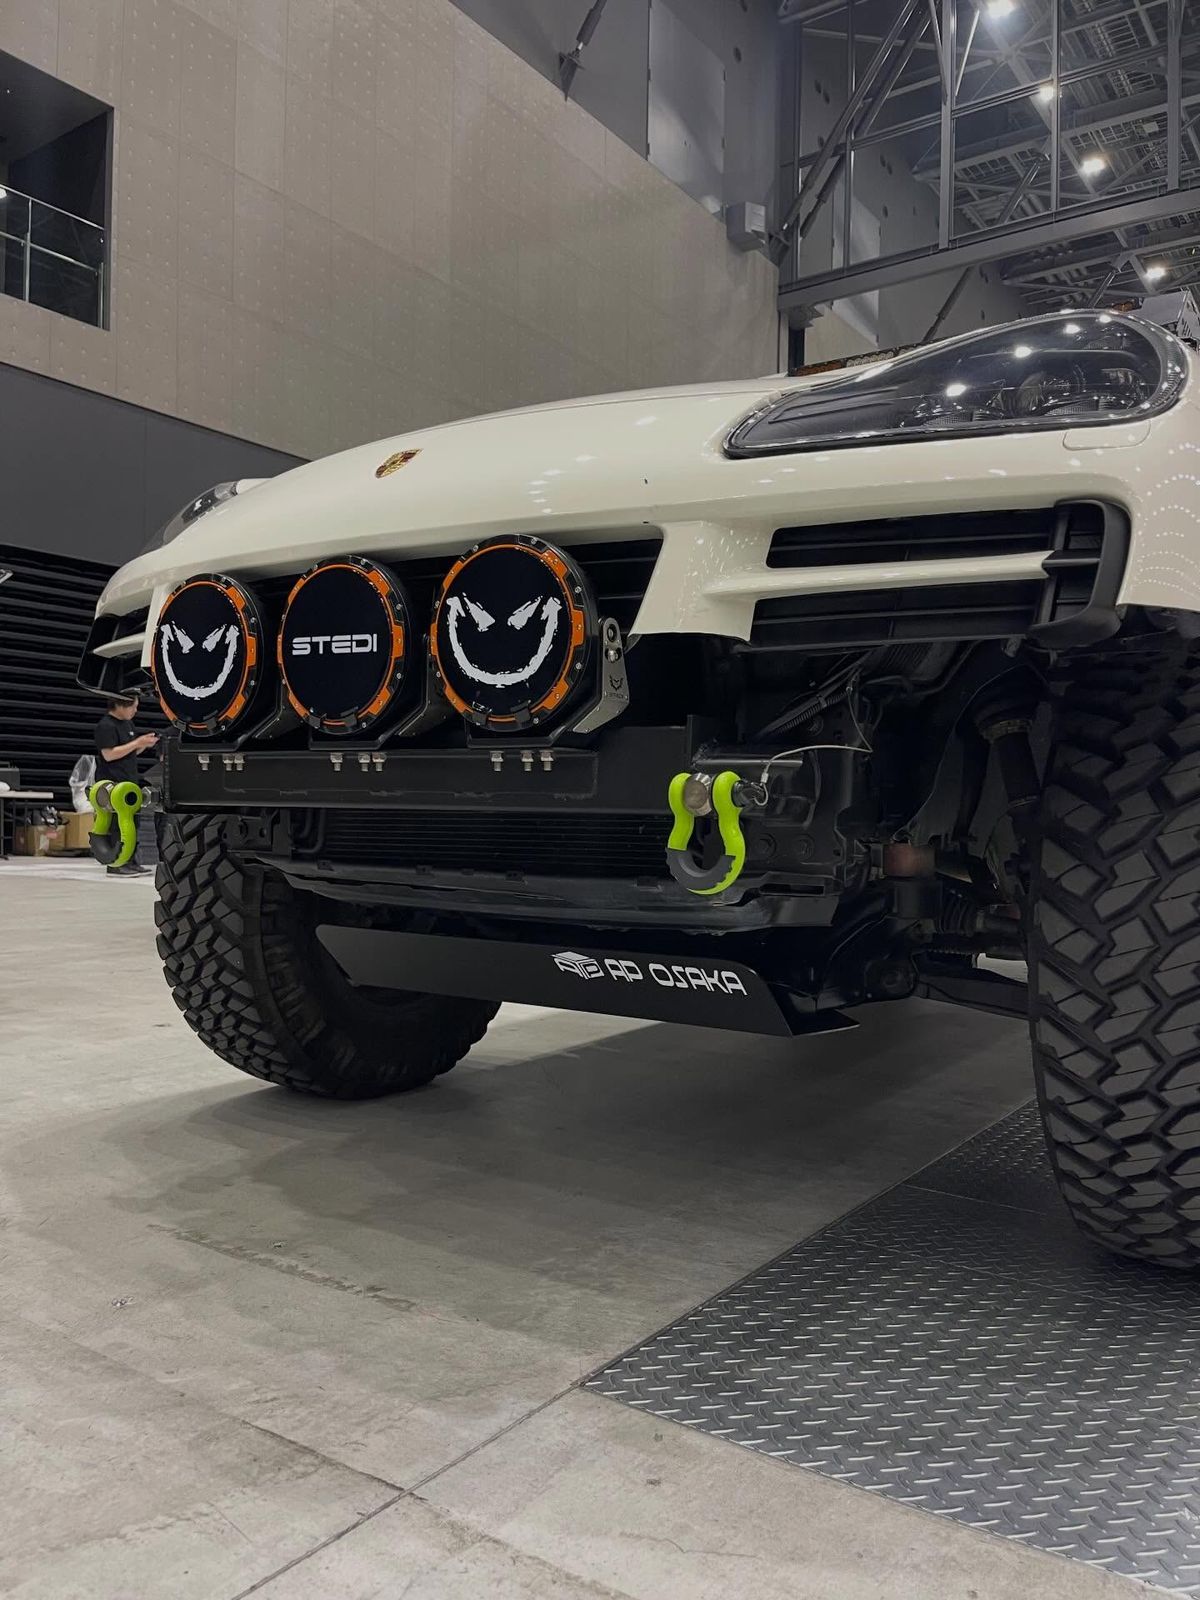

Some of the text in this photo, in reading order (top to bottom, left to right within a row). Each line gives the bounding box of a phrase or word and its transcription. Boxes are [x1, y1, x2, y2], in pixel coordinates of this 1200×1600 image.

[292, 634, 378, 656] STEDI
[604, 958, 748, 996] AP OSAKA
